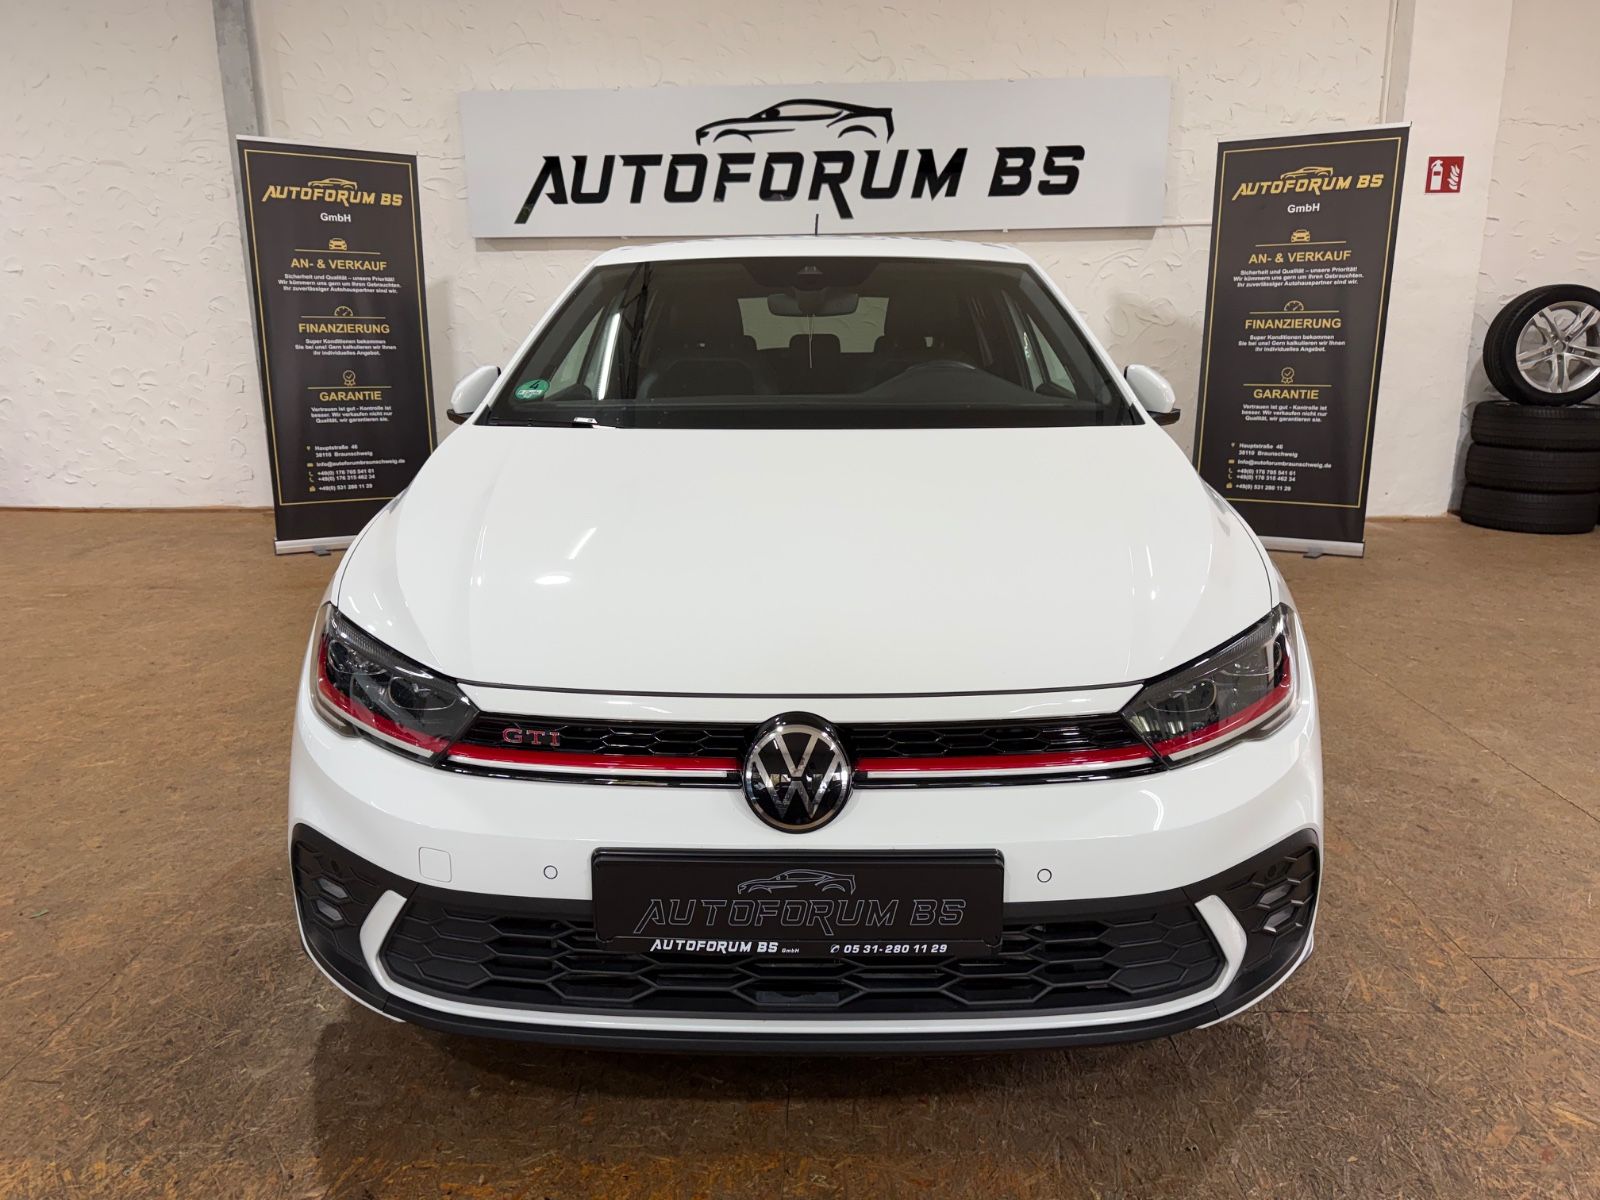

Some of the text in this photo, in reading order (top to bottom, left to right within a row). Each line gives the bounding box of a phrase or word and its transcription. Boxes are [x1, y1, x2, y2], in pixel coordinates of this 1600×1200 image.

[514, 145, 1086, 224] AUTOFORUM BS
[1232, 174, 1384, 200] AUTOFORUM BS
[262, 185, 403, 207] AUTOFORUM BS
[1287, 203, 1320, 213] GmbH
[320, 213, 351, 222] GmbH
[1248, 250, 1351, 264] AN- & VERKAUF
[291, 258, 387, 270] AN- & VERKAUF
[298, 323, 390, 333] FINANZIERUNG
[1245, 318, 1342, 329] FINANZIERUNG
[529, 380, 540, 389] 4
[320, 391, 382, 401] GARANTIE
[1254, 389, 1319, 399] GARANTIE
[502, 728, 561, 746] GTI
[633, 898, 966, 936] AUTOFORUM BS
[650, 940, 751, 954] AUTOFORUM
[757, 942, 778, 953] BS
[843, 944, 860, 953] 05
[913, 944, 928, 953] 11
[930, 944, 947, 953] 29
